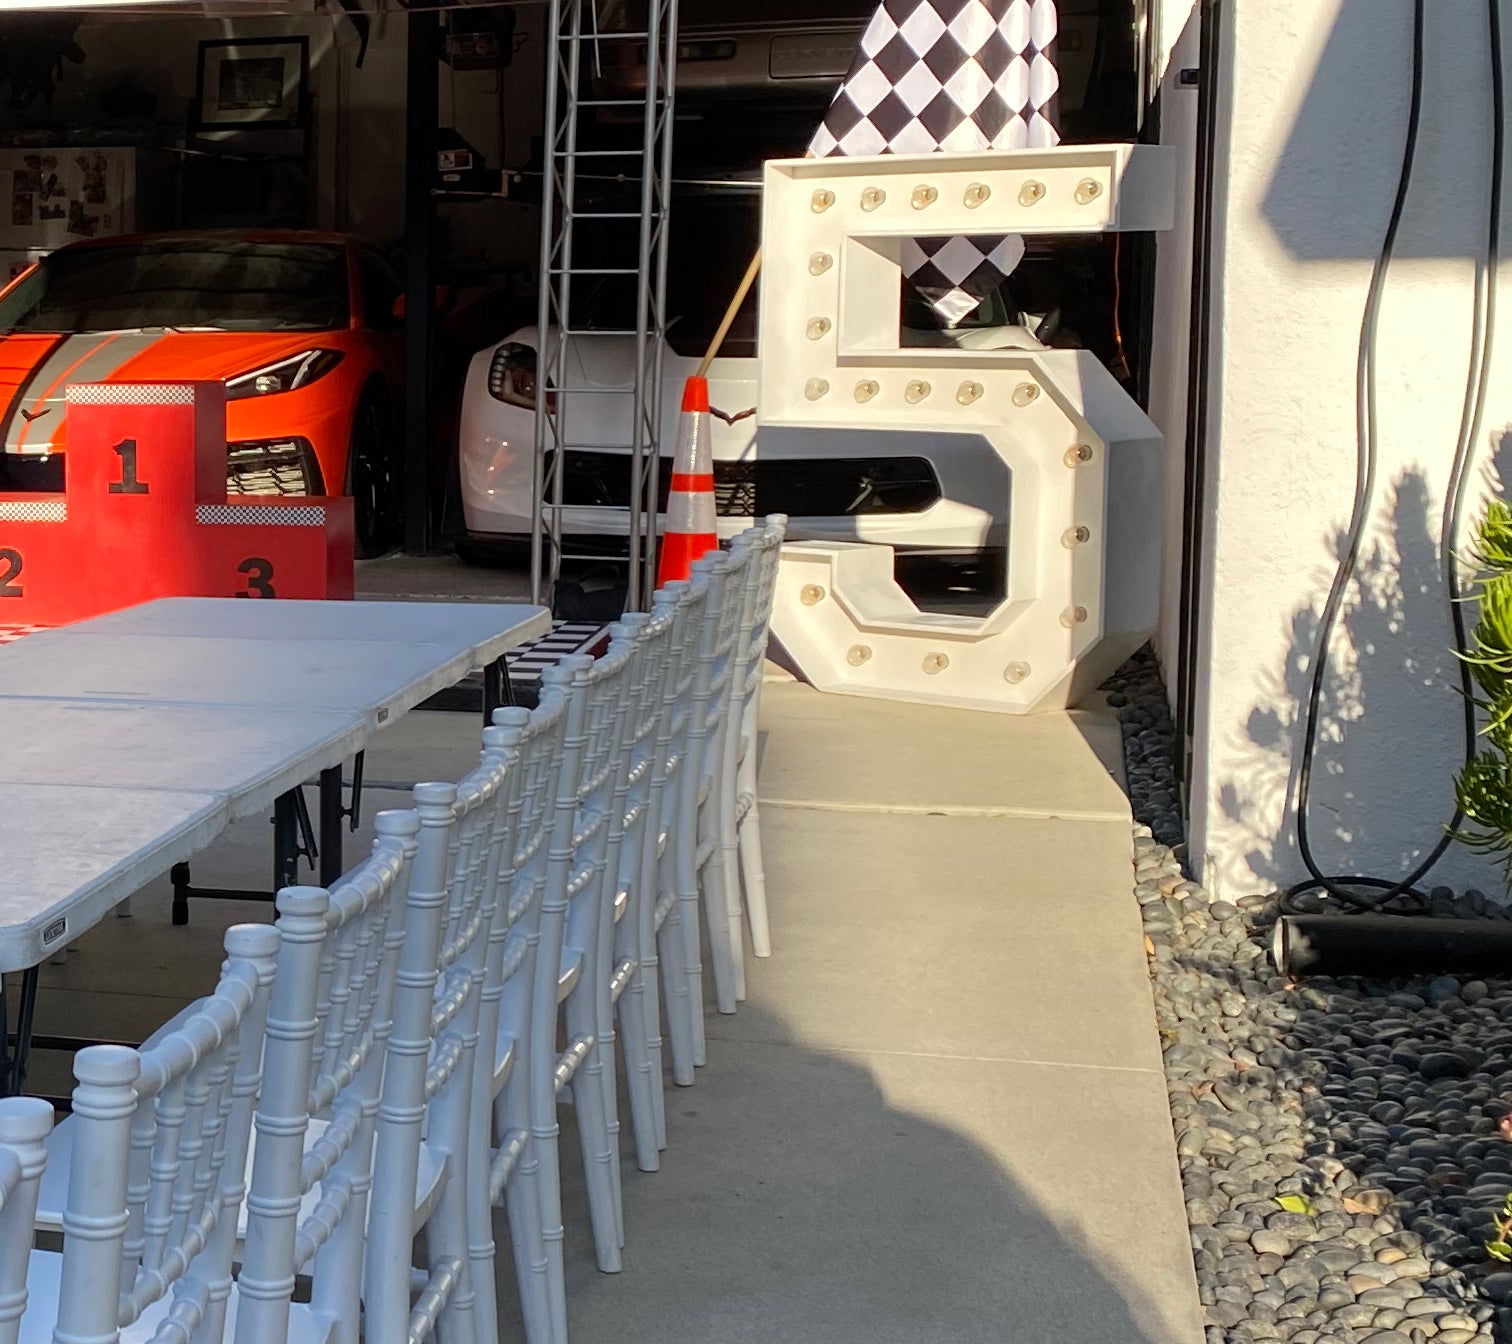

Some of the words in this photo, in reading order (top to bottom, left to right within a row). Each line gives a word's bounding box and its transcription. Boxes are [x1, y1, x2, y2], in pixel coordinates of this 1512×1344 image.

[757, 144, 1175, 714] 5
[108, 439, 150, 494] 1
[236, 557, 275, 599] 3
